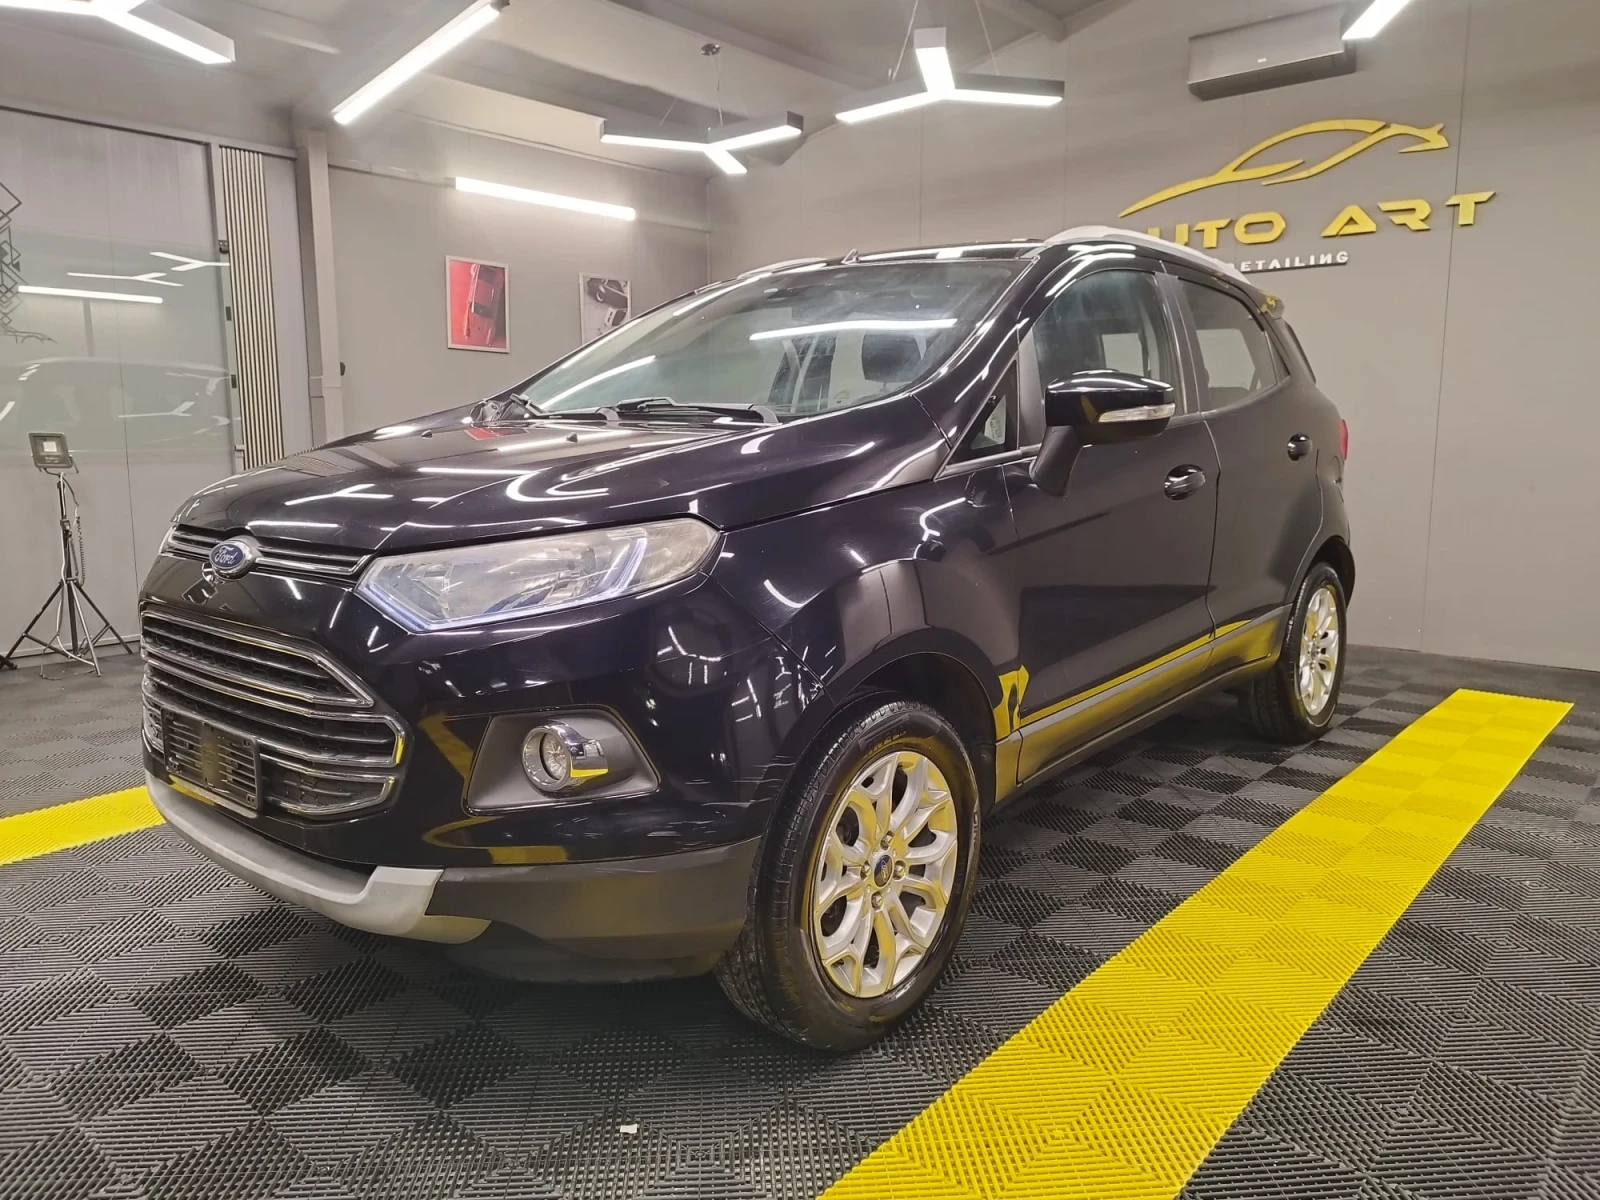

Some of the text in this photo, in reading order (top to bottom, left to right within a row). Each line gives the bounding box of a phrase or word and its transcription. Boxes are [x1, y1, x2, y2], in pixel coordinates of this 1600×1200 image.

[1147, 191, 1496, 249] UTO ART
[1232, 251, 1349, 272] ETAILING
[214, 545, 239, 565] Ford
